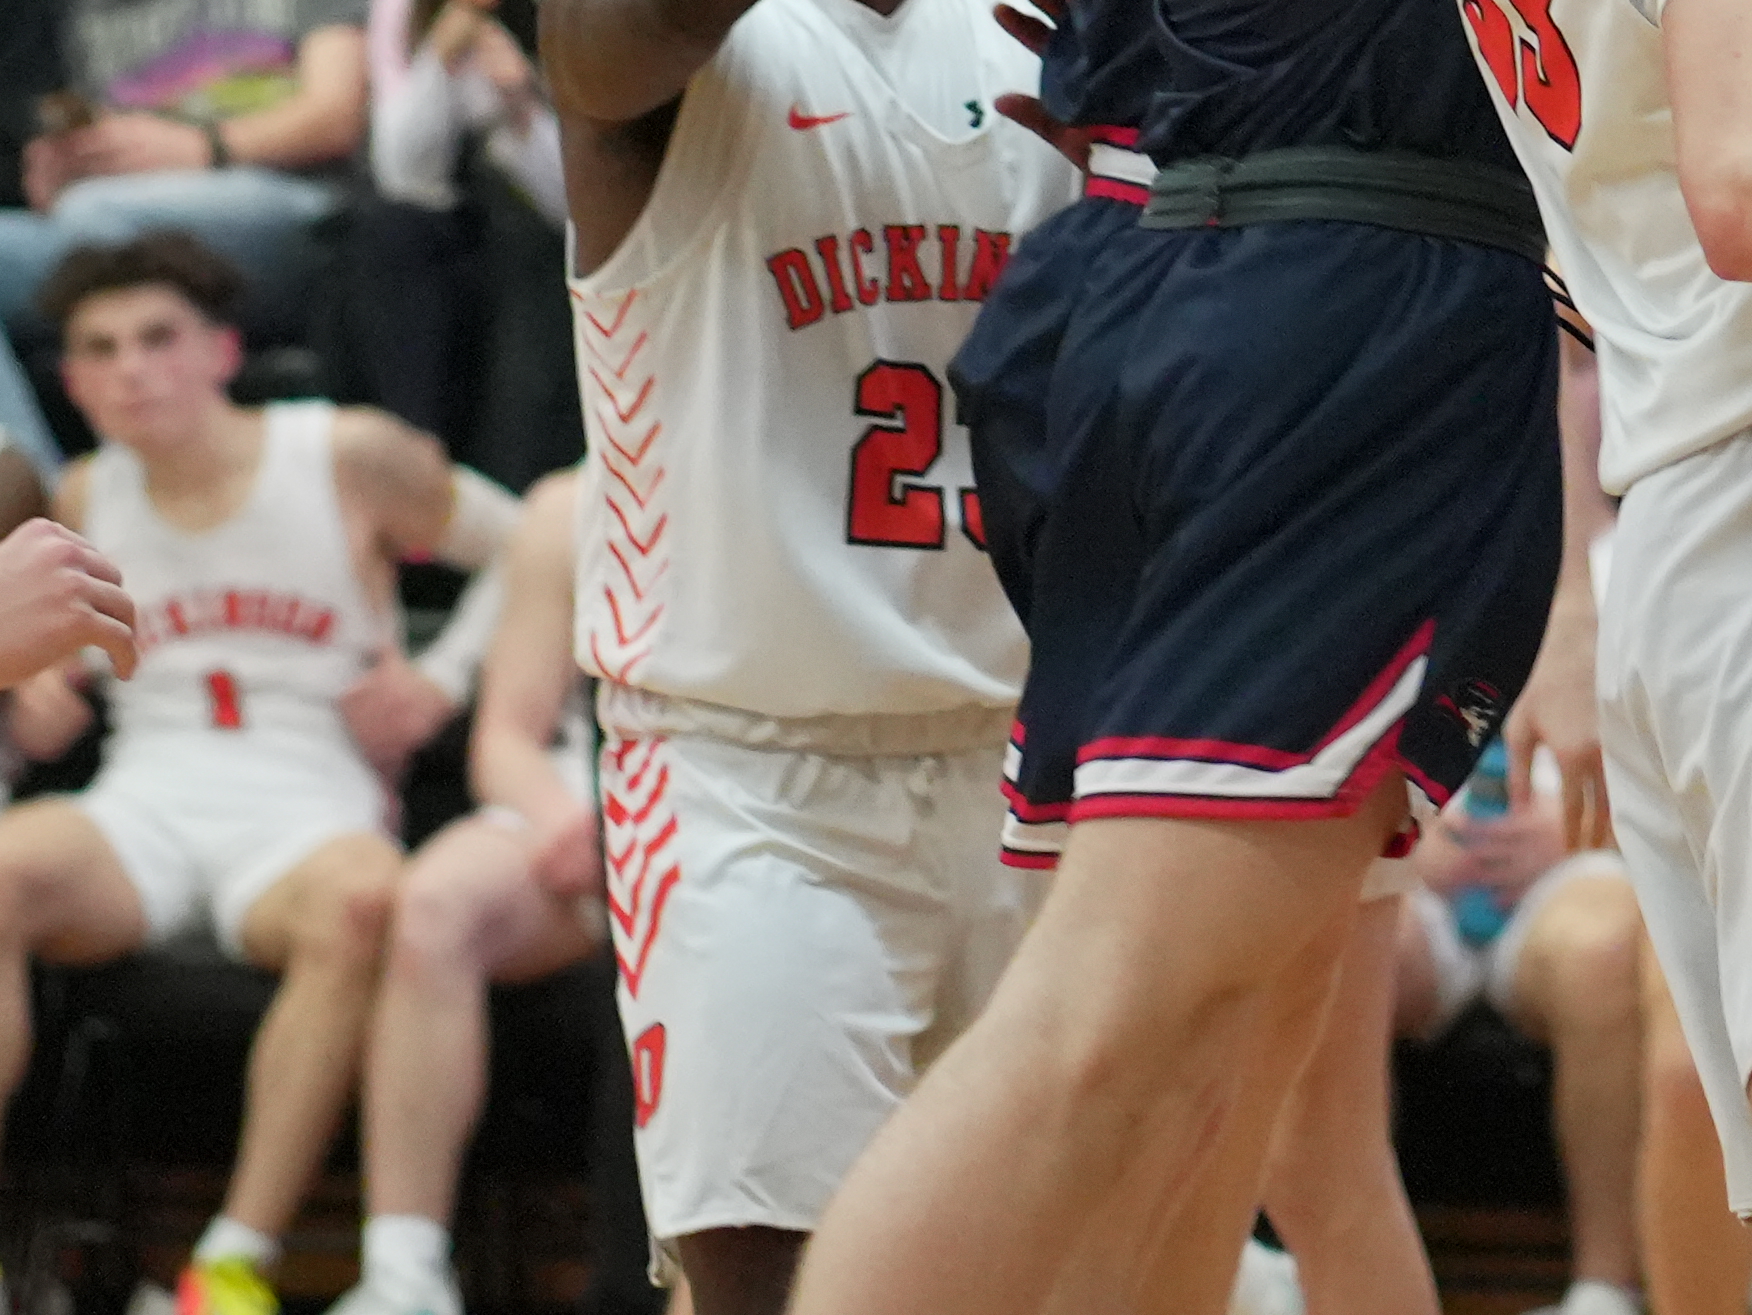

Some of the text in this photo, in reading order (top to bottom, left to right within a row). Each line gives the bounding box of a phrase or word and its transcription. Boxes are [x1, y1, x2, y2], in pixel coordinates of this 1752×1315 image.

[767, 223, 1014, 331] DICKIN
[845, 357, 990, 551] 2
[204, 668, 244, 731] 1
